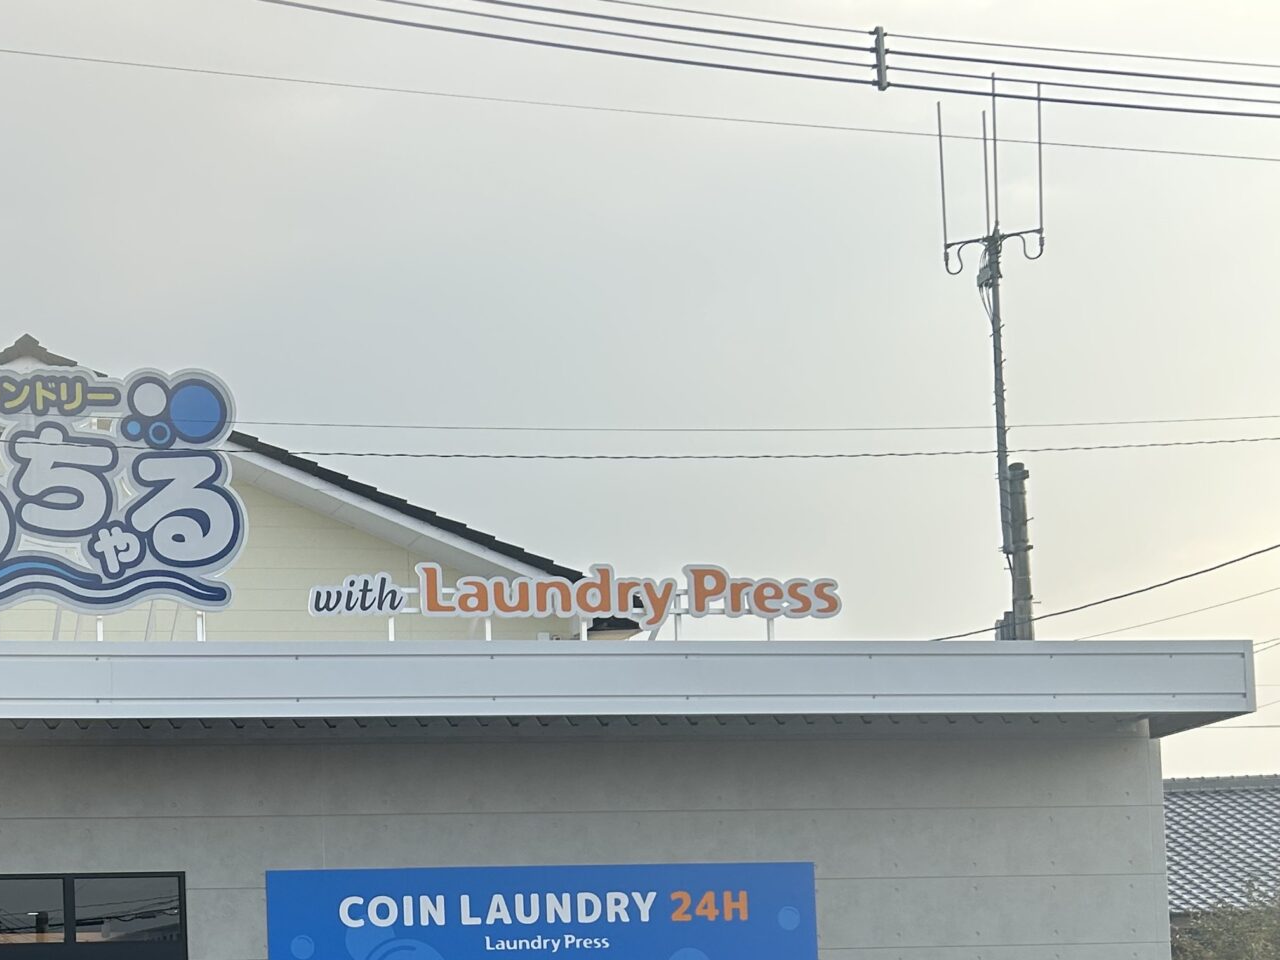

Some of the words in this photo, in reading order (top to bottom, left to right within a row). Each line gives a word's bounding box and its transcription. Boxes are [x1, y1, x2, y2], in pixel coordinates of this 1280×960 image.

[314, 576, 404, 613] with
[421, 566, 676, 625] Laundry
[690, 567, 839, 616] Press
[338, 895, 446, 928] COIN
[459, 891, 657, 925] LAUNDRY
[669, 890, 750, 922] 24H
[485, 935, 561, 952] Laundry
[564, 934, 610, 949] Press
